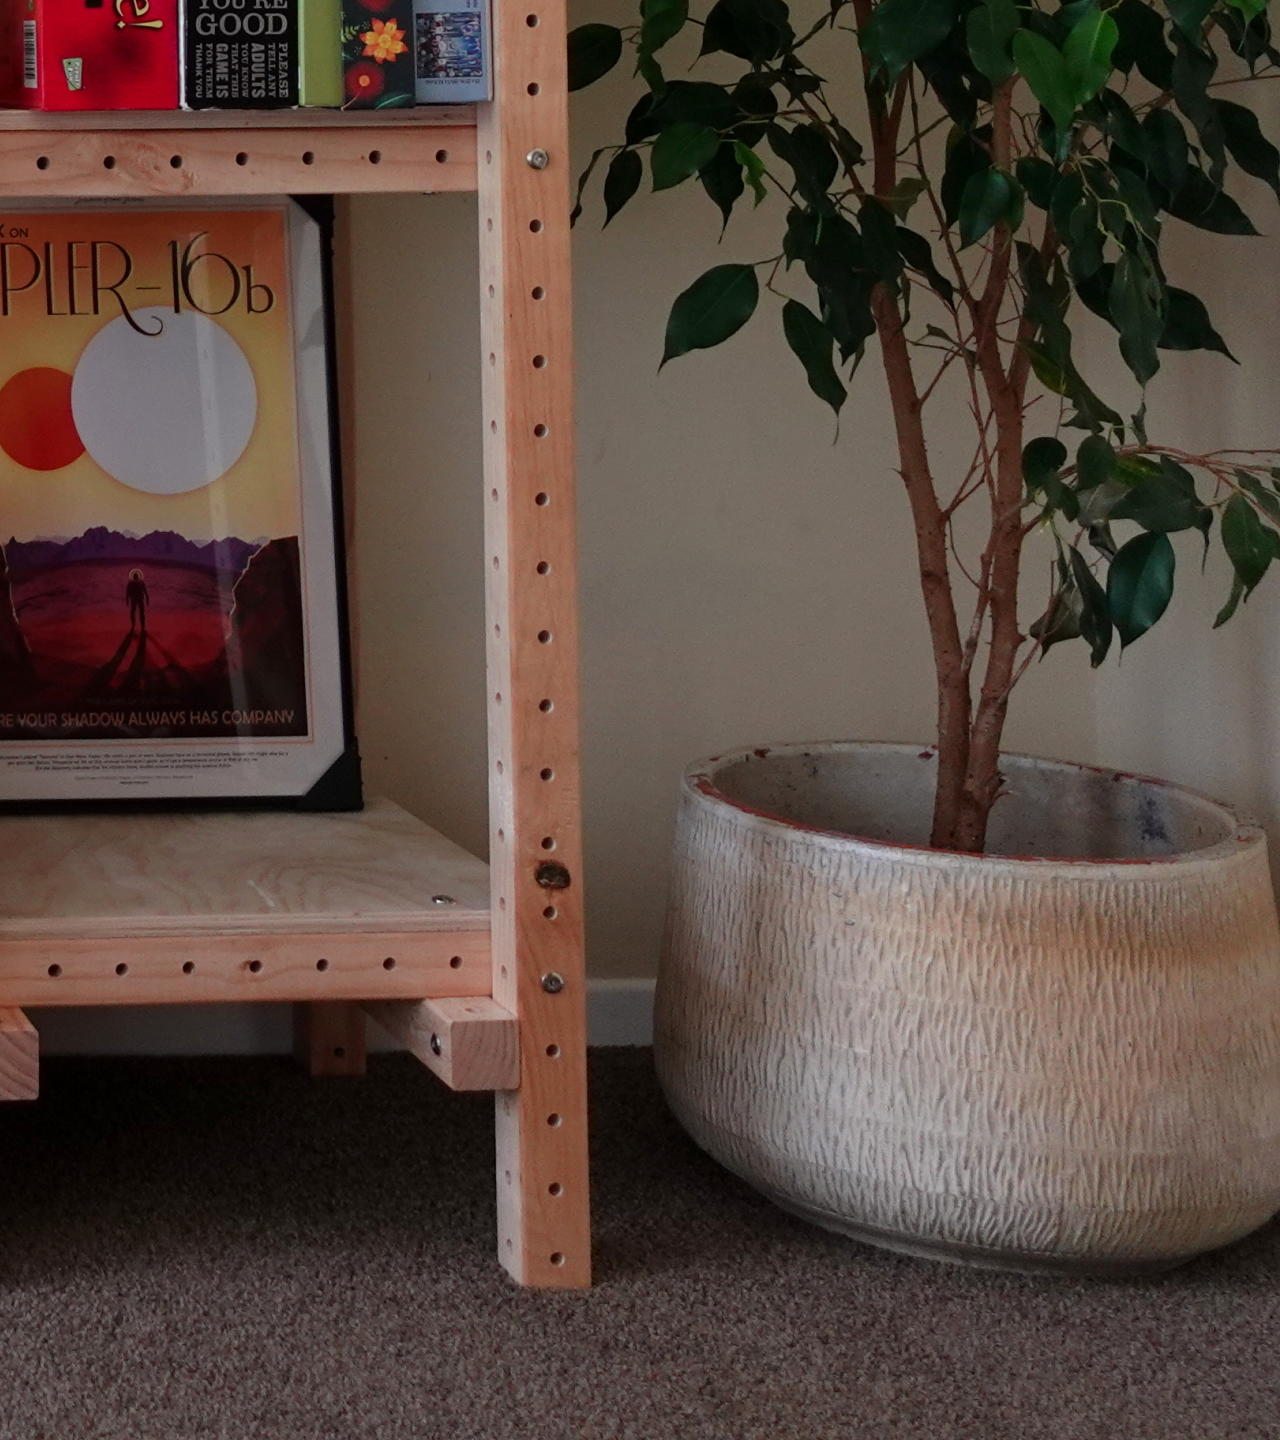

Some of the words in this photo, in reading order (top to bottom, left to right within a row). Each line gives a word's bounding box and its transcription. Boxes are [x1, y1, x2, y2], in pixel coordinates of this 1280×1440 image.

[196, 13, 288, 35] GOOD
[216, 43, 228, 80] GAME
[252, 43, 266, 98] ADULTS
[17, 712, 57, 727] YOUR
[61, 712, 125, 727] SHADOW
[129, 711, 186, 726] ALWAYS
[190, 711, 218, 725] HAS
[222, 710, 294, 725] COMPANY
